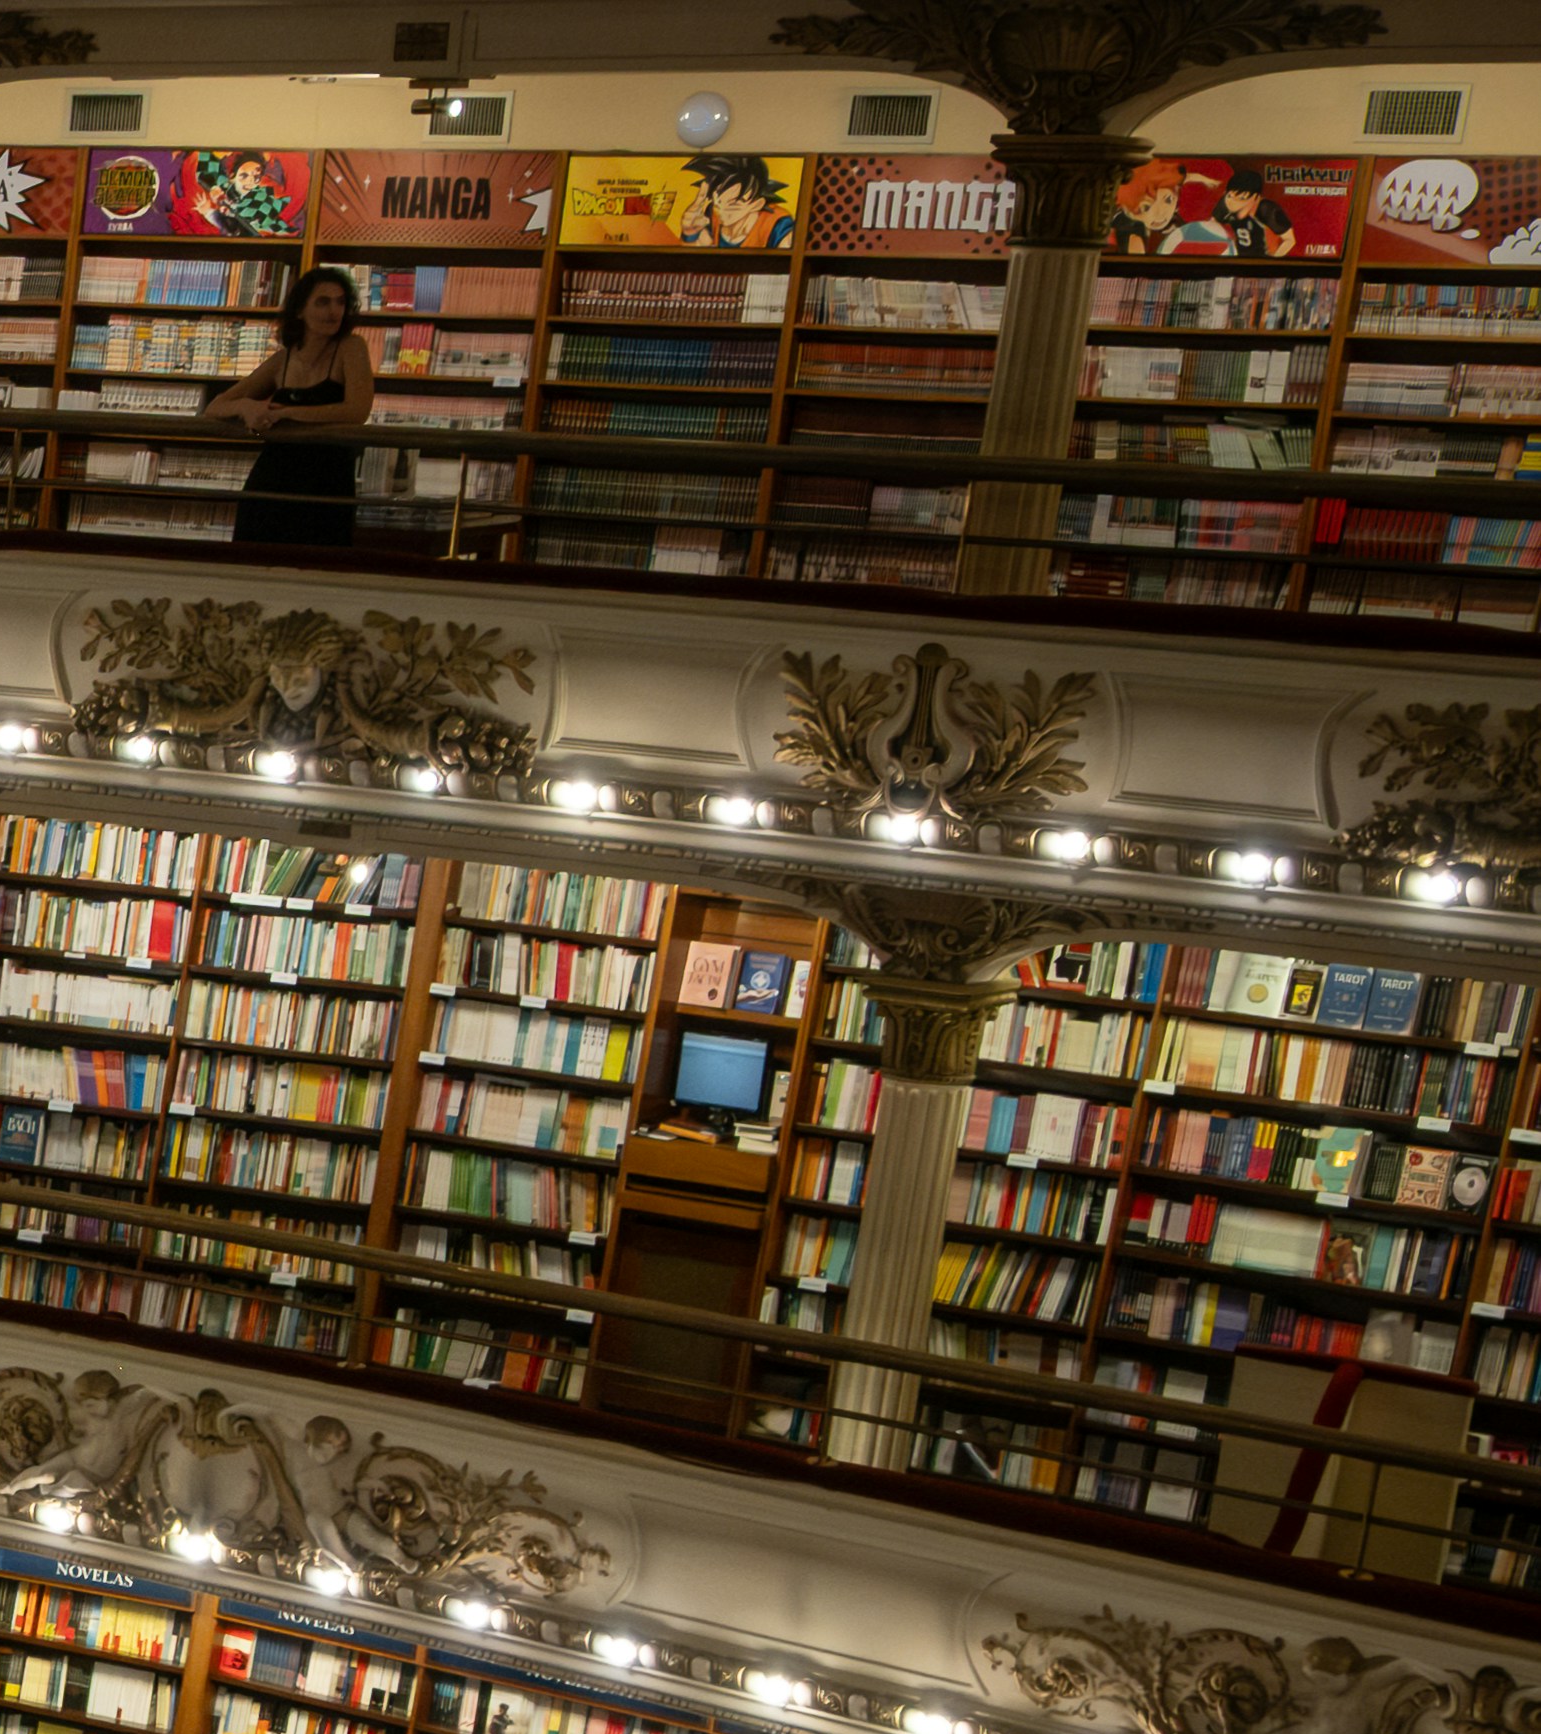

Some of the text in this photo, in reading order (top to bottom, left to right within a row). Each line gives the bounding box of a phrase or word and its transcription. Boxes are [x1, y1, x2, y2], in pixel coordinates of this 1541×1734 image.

[381, 176, 491, 220] MANGA
[1333, 972, 1367, 987] TAROT
[1380, 976, 1414, 991] TAROT
[56, 1561, 134, 1588] NOVELAS
